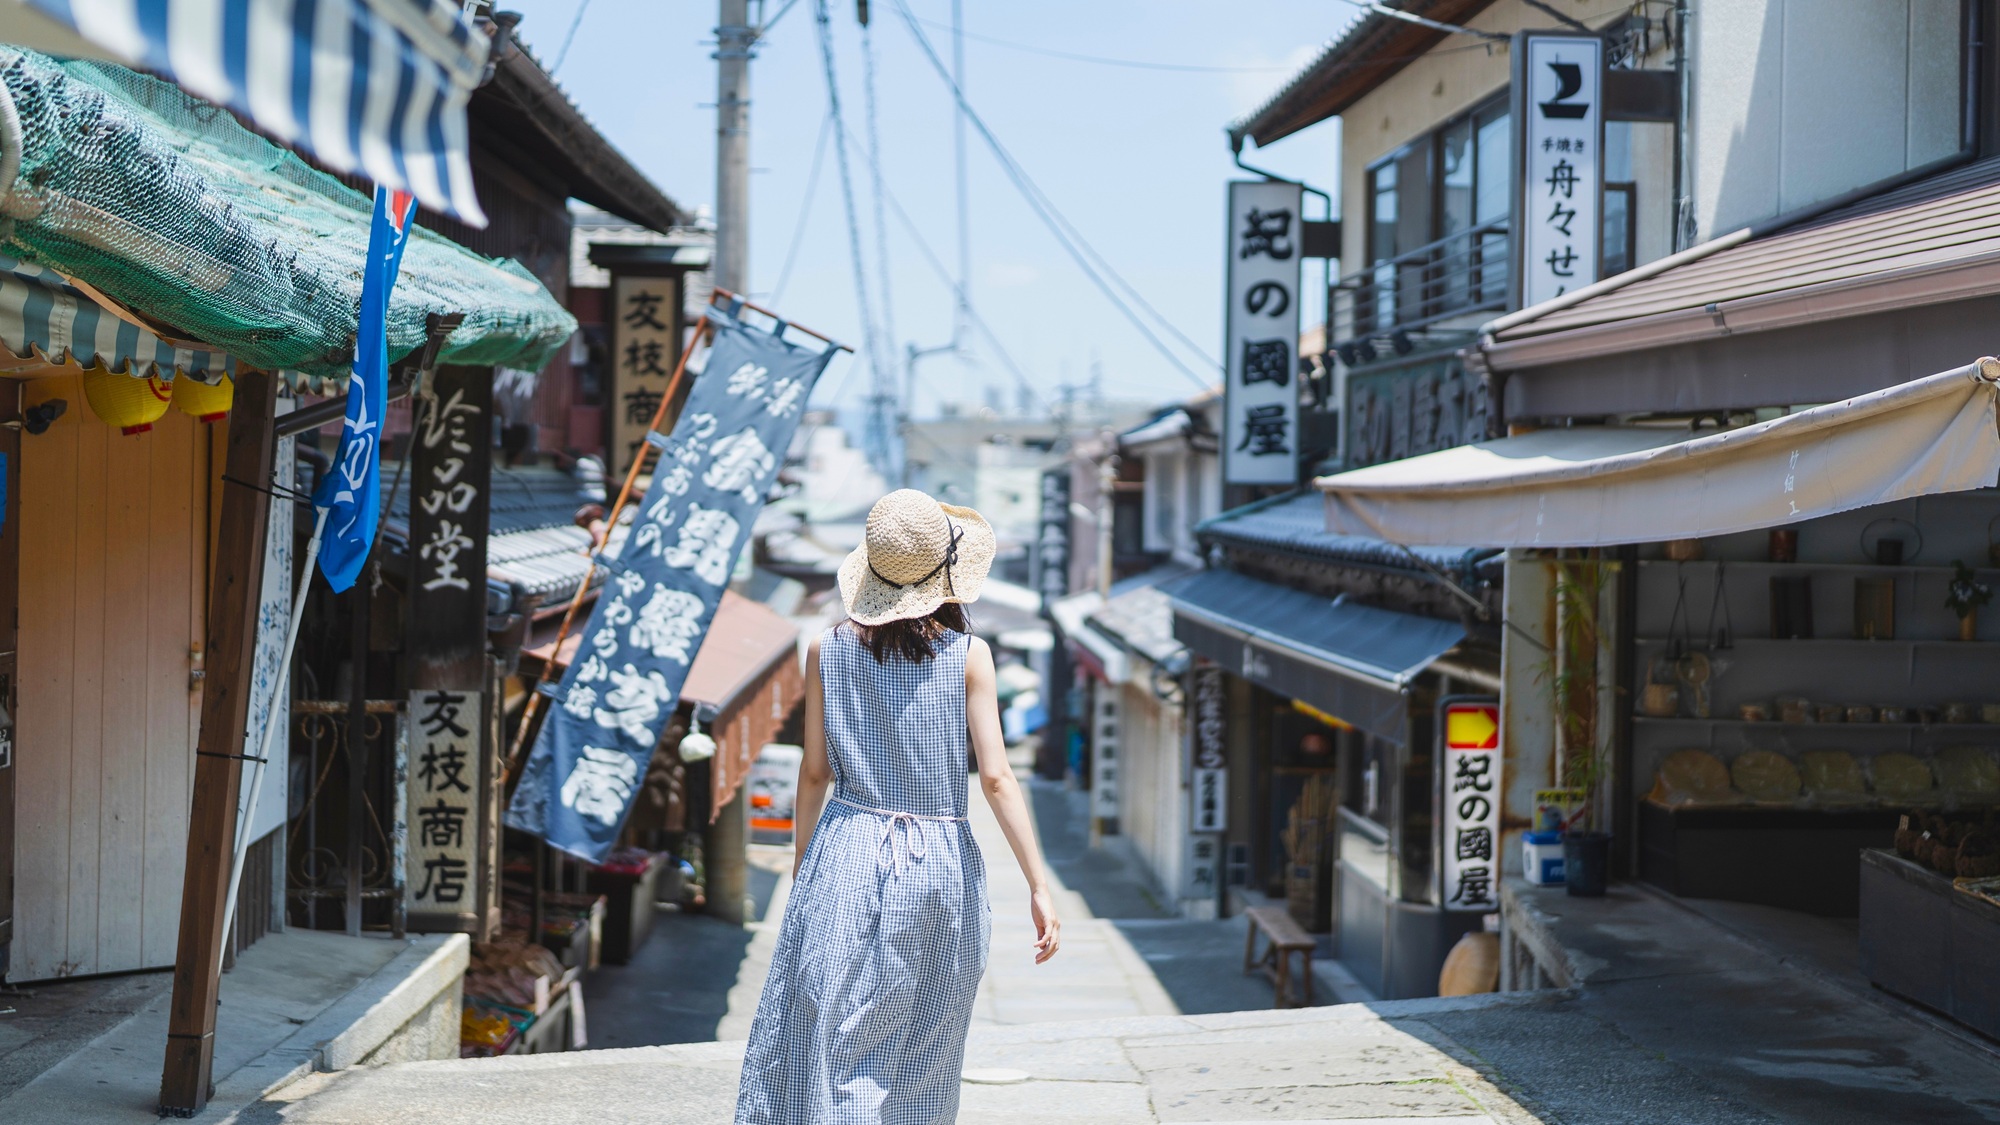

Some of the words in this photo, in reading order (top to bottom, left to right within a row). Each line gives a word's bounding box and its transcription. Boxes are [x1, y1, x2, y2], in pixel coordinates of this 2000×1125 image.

[1541, 137, 1585, 154] 手焼き
[1545, 159, 1581, 298] 舟々せ
[1237, 207, 1294, 457] 紀の國屋
[414, 690, 471, 903] 友枝商店
[1450, 752, 1493, 906] 紀の國屋
